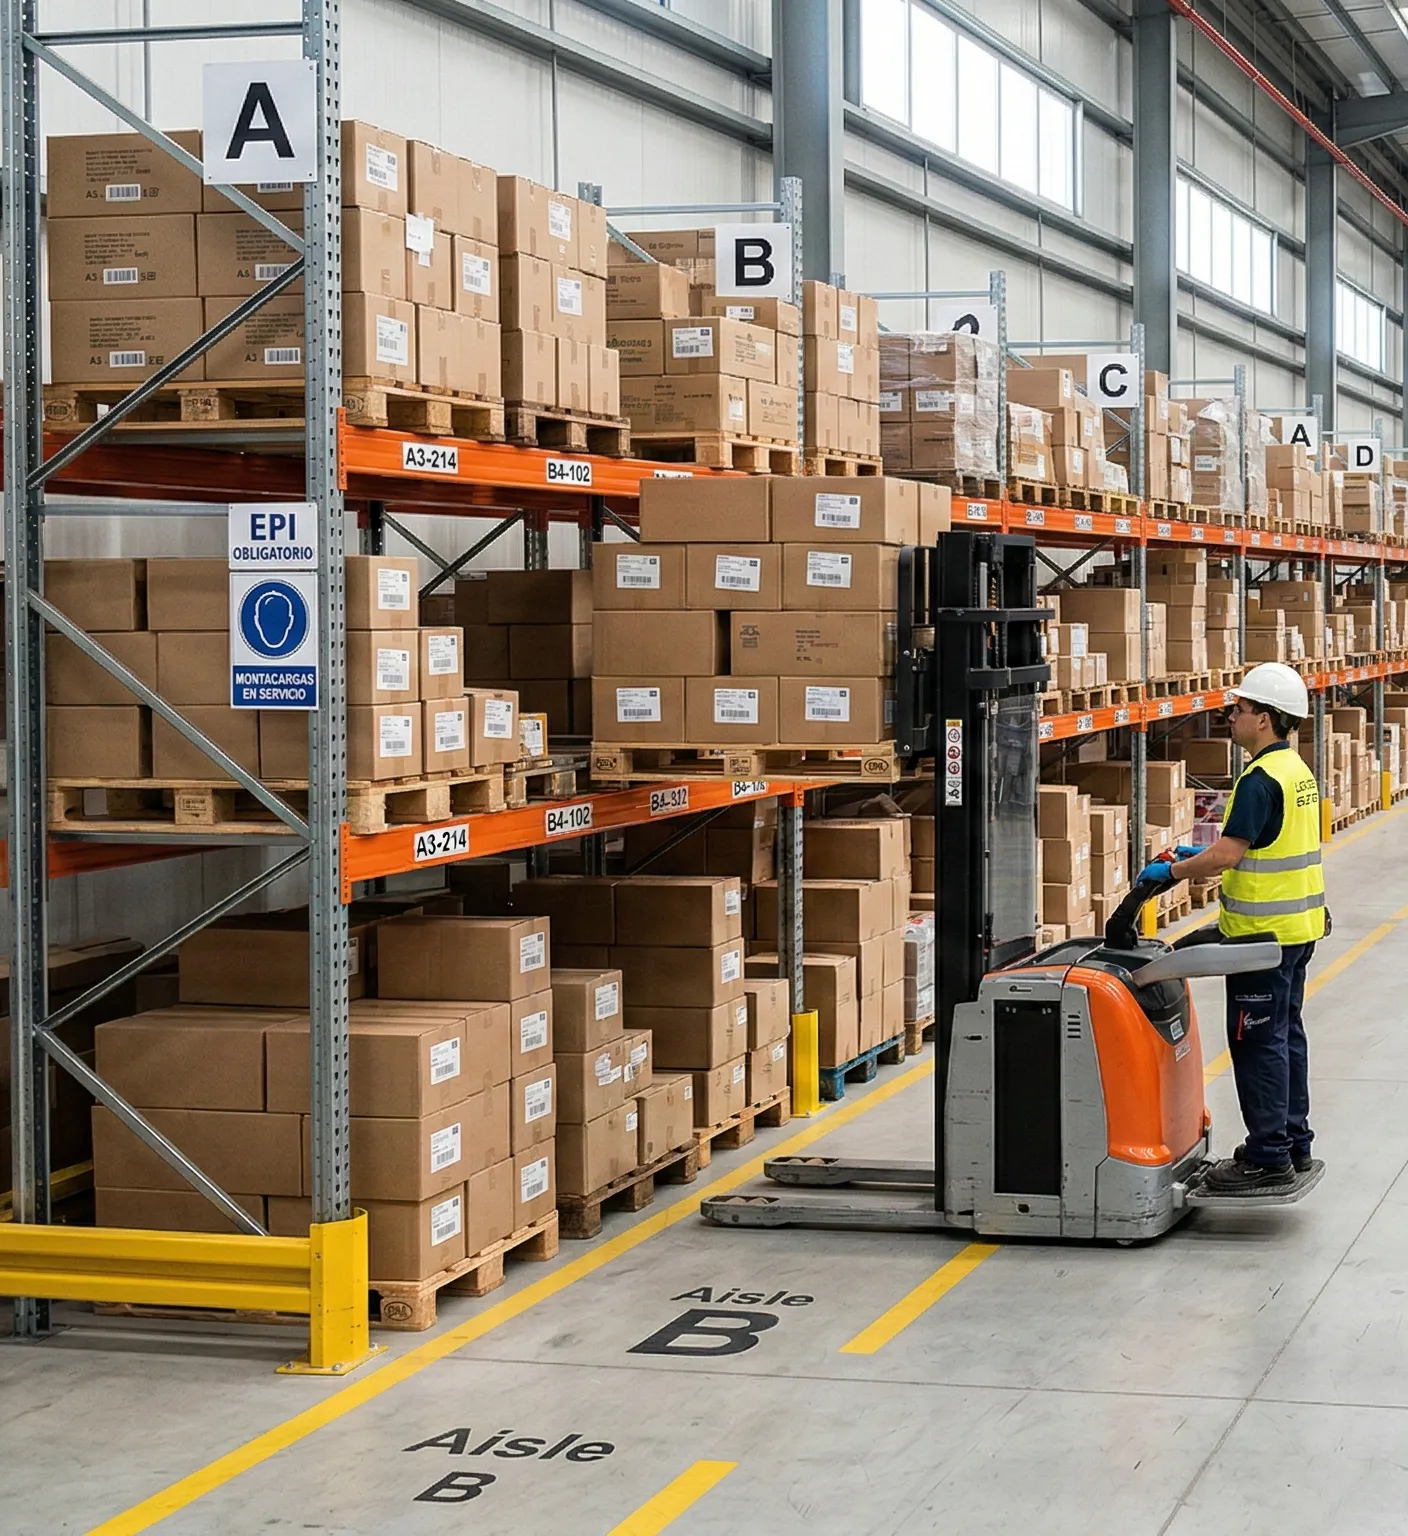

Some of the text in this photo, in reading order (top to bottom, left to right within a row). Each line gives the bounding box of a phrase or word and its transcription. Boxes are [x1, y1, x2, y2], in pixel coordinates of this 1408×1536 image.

[225, 82, 295, 160] A
[734, 238, 775, 287] B
[1099, 363, 1128, 397] C
[1290, 424, 1311, 447] A
[405, 447, 457, 469] A3-214
[1356, 446, 1374, 467] D
[548, 462, 590, 483] B4-102
[250, 513, 296, 541] EPI
[232, 546, 313, 561] OBLIGATORIO
[235, 672, 315, 686] MONTACARGAS
[242, 687, 306, 701] EN SERVICIO
[547, 805, 591, 833] B4-102
[416, 827, 467, 859] A3-214
[670, 1286, 815, 1307] Aisle
[625, 1308, 780, 1356] B
[401, 1427, 615, 1463] Aisle
[412, 1471, 497, 1503] B
